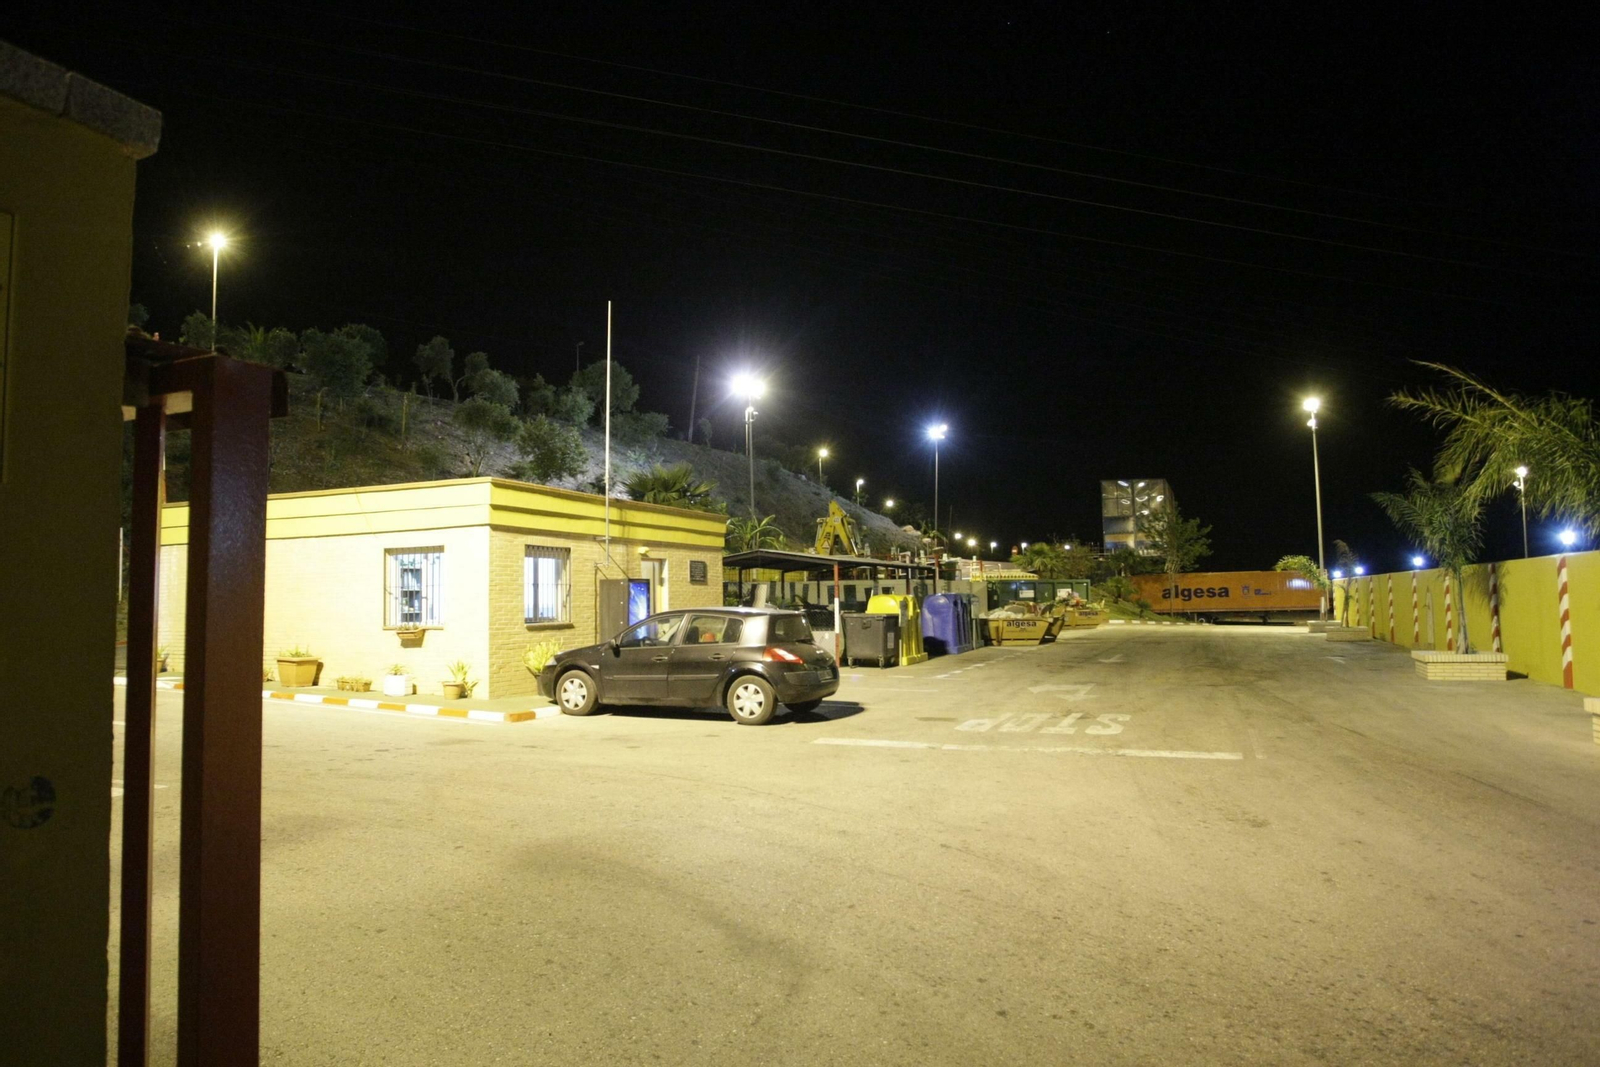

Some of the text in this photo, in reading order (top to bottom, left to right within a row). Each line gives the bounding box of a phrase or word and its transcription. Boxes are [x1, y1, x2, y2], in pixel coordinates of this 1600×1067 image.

[1161, 584, 1230, 602] algesa
[1006, 620, 1037, 628] algesa
[954, 712, 1132, 735] STOP
